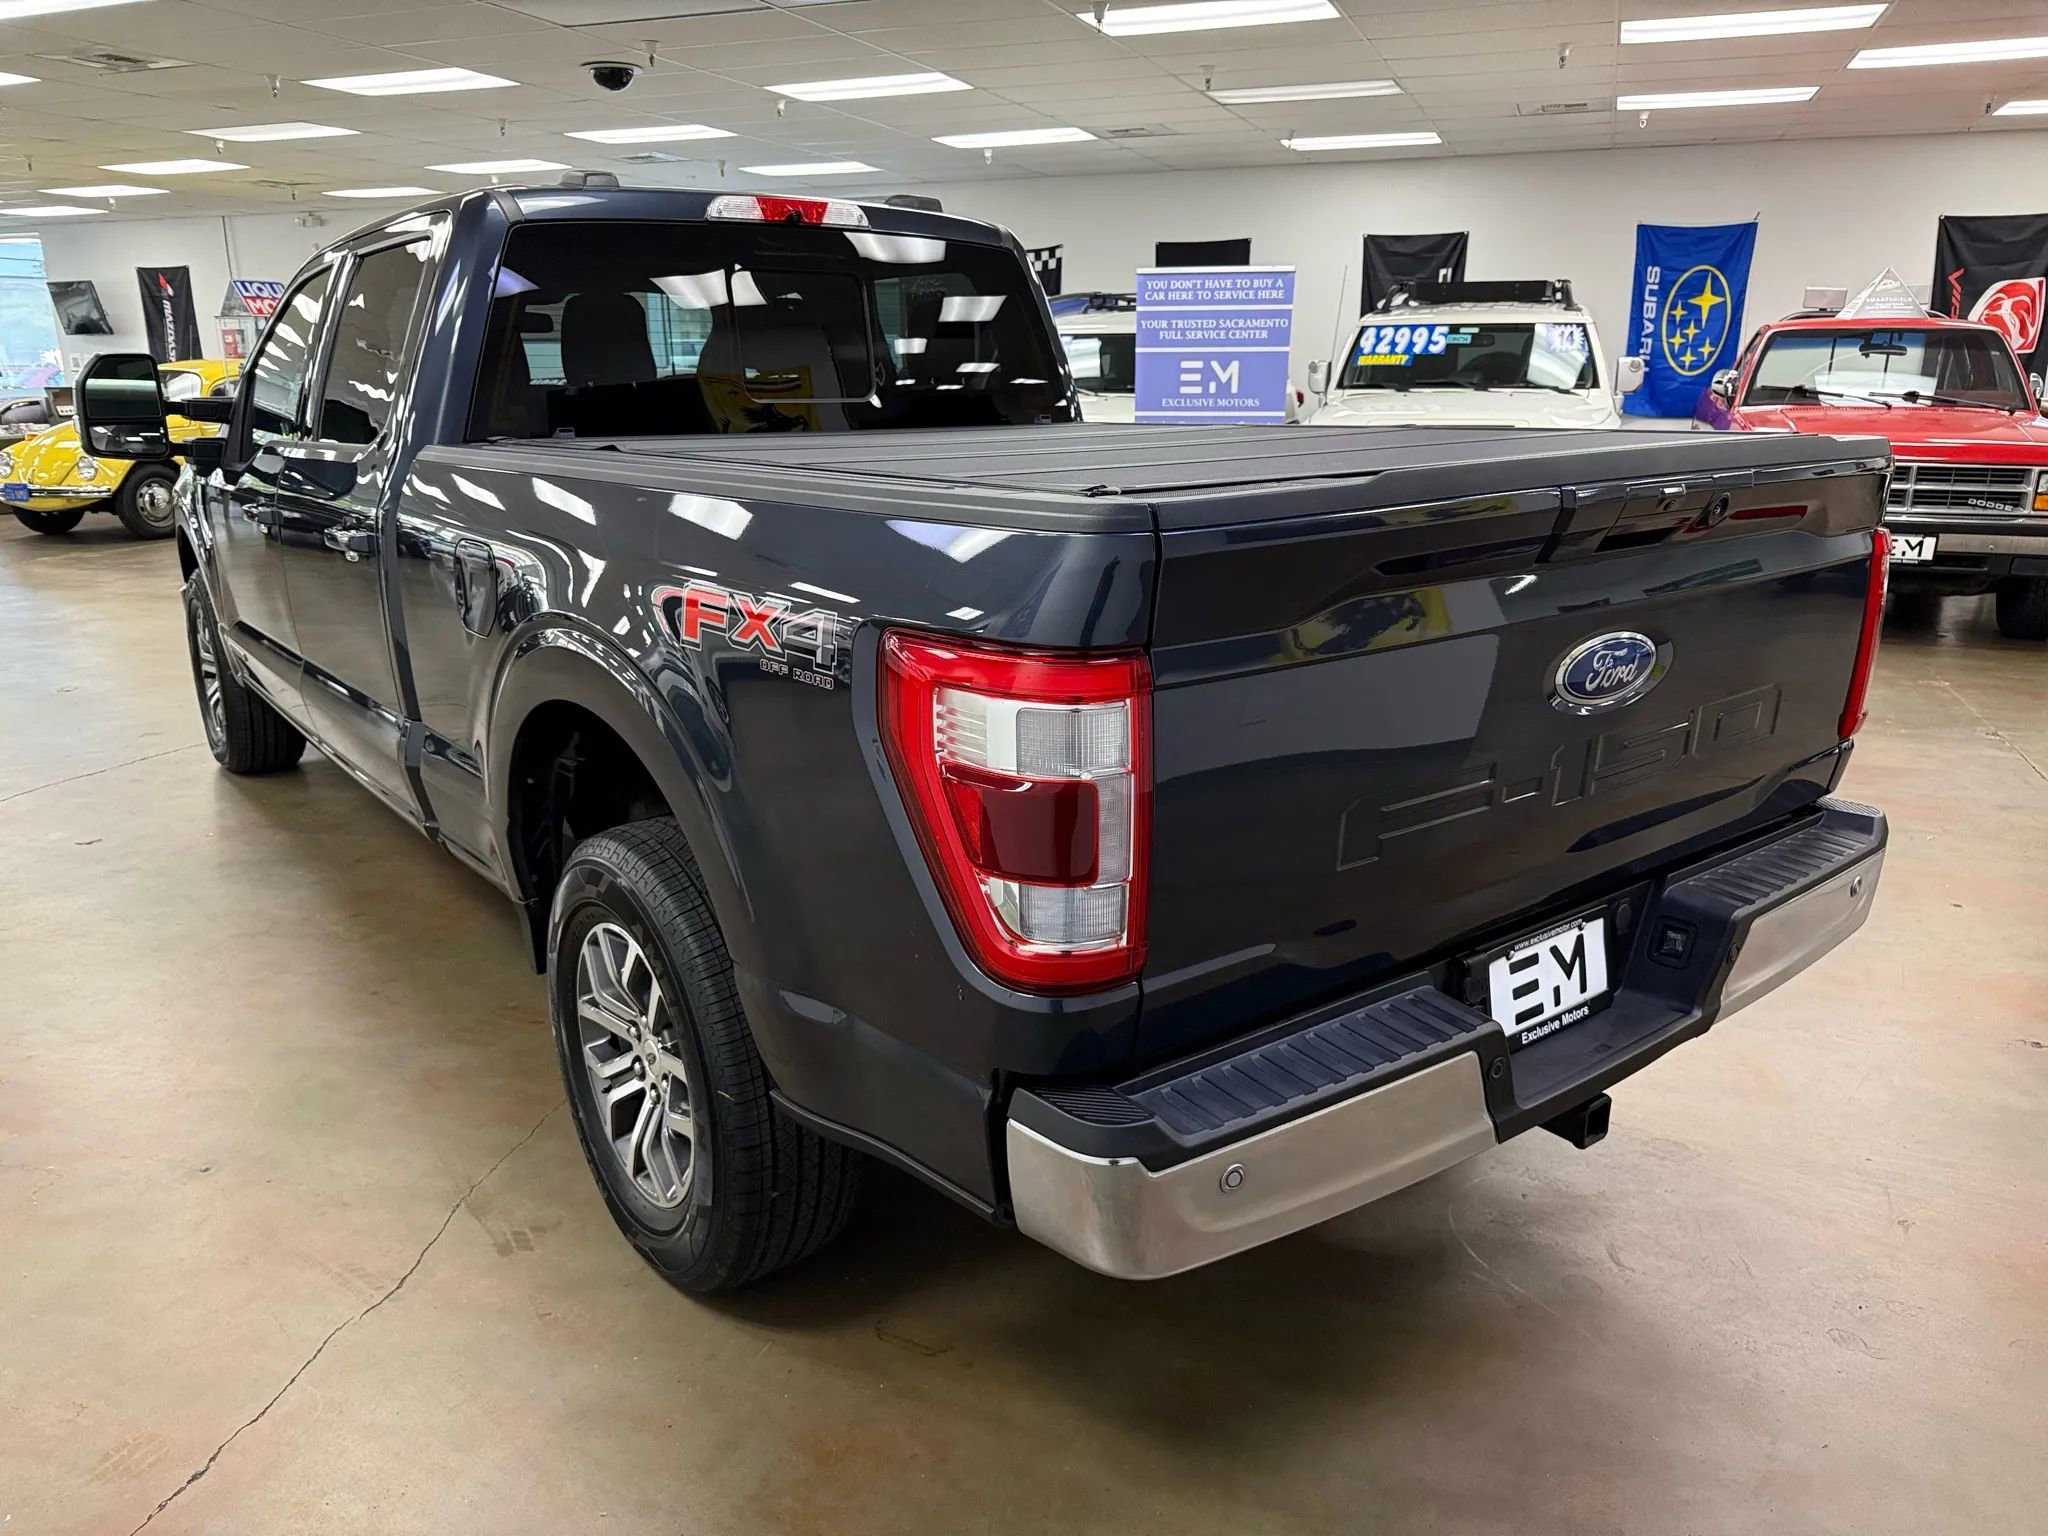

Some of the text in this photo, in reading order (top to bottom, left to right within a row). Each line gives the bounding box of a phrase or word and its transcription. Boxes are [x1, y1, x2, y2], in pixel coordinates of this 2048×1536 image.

[1145, 289, 1285, 301] CAR HERE TO SERVICE HERE
[1146, 278, 1284, 289] YOU DON'T HAVE TO BUY A
[1141, 318, 1289, 329] YOUR TRUSTED SACRAMENTO
[1159, 329, 1269, 340] FULL SERVICE CENTER
[1360, 326, 1449, 355] 42995
[1179, 360, 1240, 394] EM
[1161, 398, 1260, 407] EXCLUSIVE MOTORS
[1967, 498, 2014, 512] DODGE
[680, 580, 838, 675] FX4
[759, 658, 835, 690] OFF ROAD
[1585, 648, 1639, 691] Ford
[1336, 683, 1783, 871] F-150
[1509, 933, 1588, 1026] EM
[1521, 1004, 1590, 1045] Exclusive Motors
